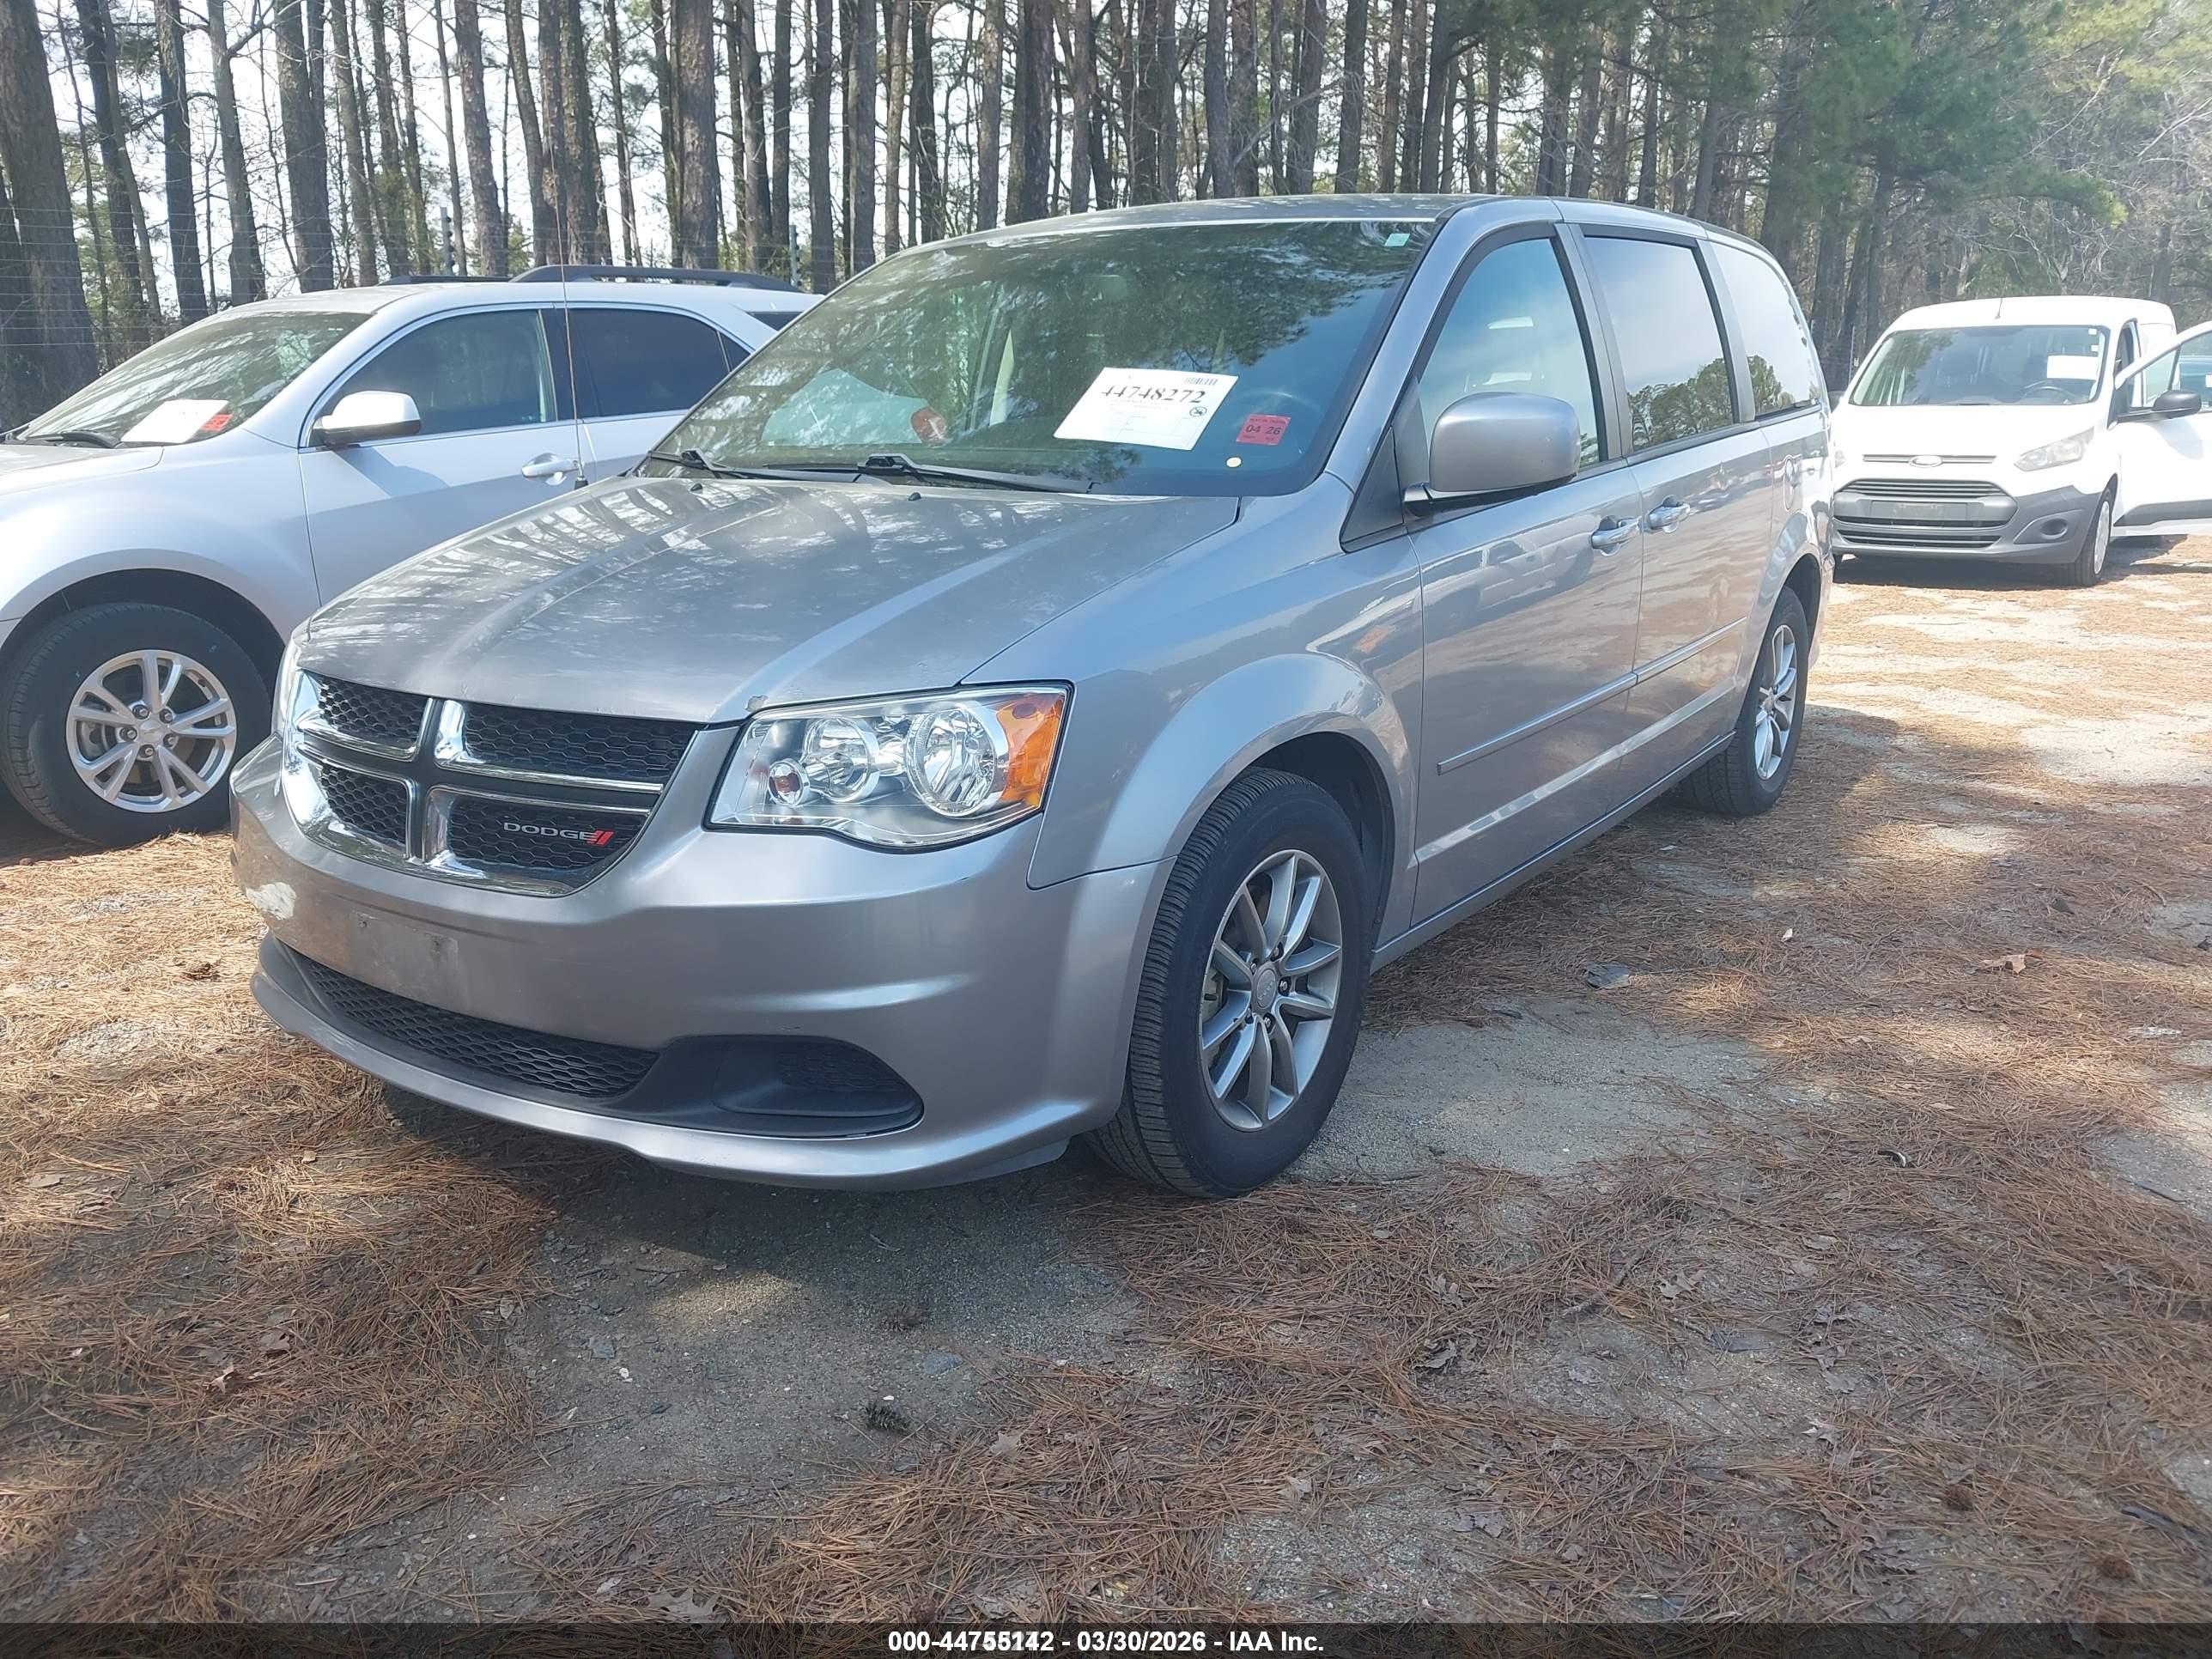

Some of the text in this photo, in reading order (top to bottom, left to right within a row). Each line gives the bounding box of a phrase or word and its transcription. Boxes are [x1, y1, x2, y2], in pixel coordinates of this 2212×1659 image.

[1102, 386, 1206, 404] 44748272
[1245, 424, 1281, 435] 04 26
[503, 822, 599, 842] DODGE
